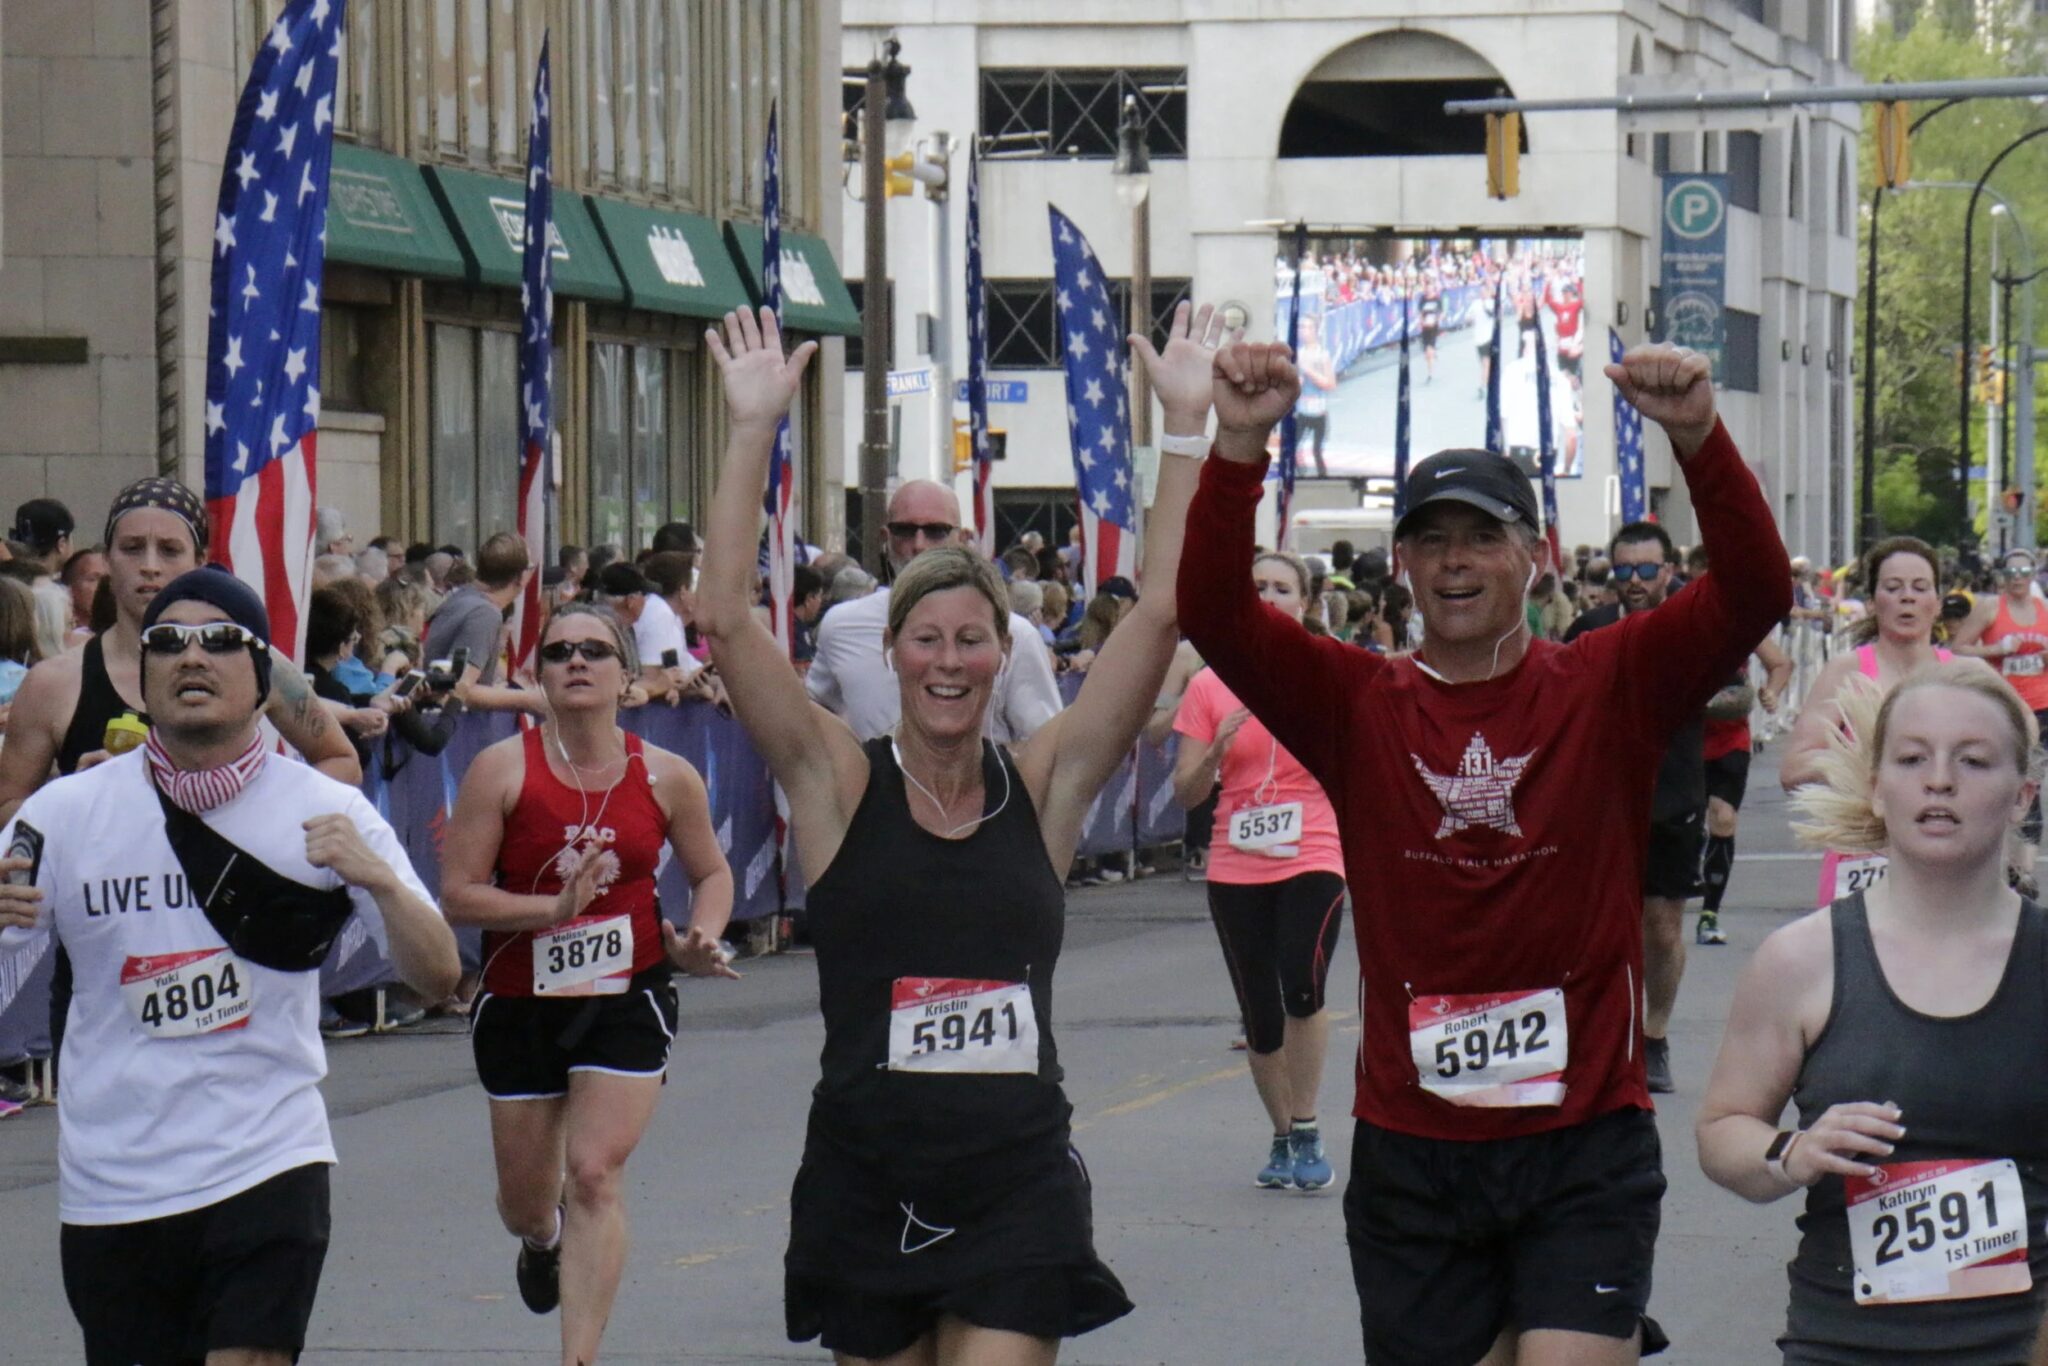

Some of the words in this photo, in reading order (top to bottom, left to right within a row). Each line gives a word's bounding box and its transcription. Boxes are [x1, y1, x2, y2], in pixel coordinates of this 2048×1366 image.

[1683, 194, 1710, 227] P
[958, 383, 1011, 401] CRT
[1463, 752, 1492, 776] 13.1
[1239, 810, 1294, 840] 5537
[1404, 849, 1453, 865] BUFFALO
[1458, 859, 1489, 868] HALF
[1494, 846, 1559, 867] MARATHON
[83, 875, 152, 917] LIVE
[547, 929, 622, 974] 3878
[551, 929, 588, 944] Melissa
[141, 962, 240, 1028] 4804
[153, 973, 180, 988] Yuki
[195, 1012, 214, 1029] 1st
[217, 999, 249, 1020] Timer
[924, 999, 968, 1017] Kristin
[912, 1001, 1018, 1056] 5941
[1444, 1012, 1489, 1035] Robert
[1435, 1010, 1549, 1078] 5942
[1878, 1183, 1937, 1212] Kathryn
[1872, 1180, 1999, 1267] 2591
[1945, 1243, 1970, 1264] 1st
[1974, 1229, 2019, 1254] Timer
